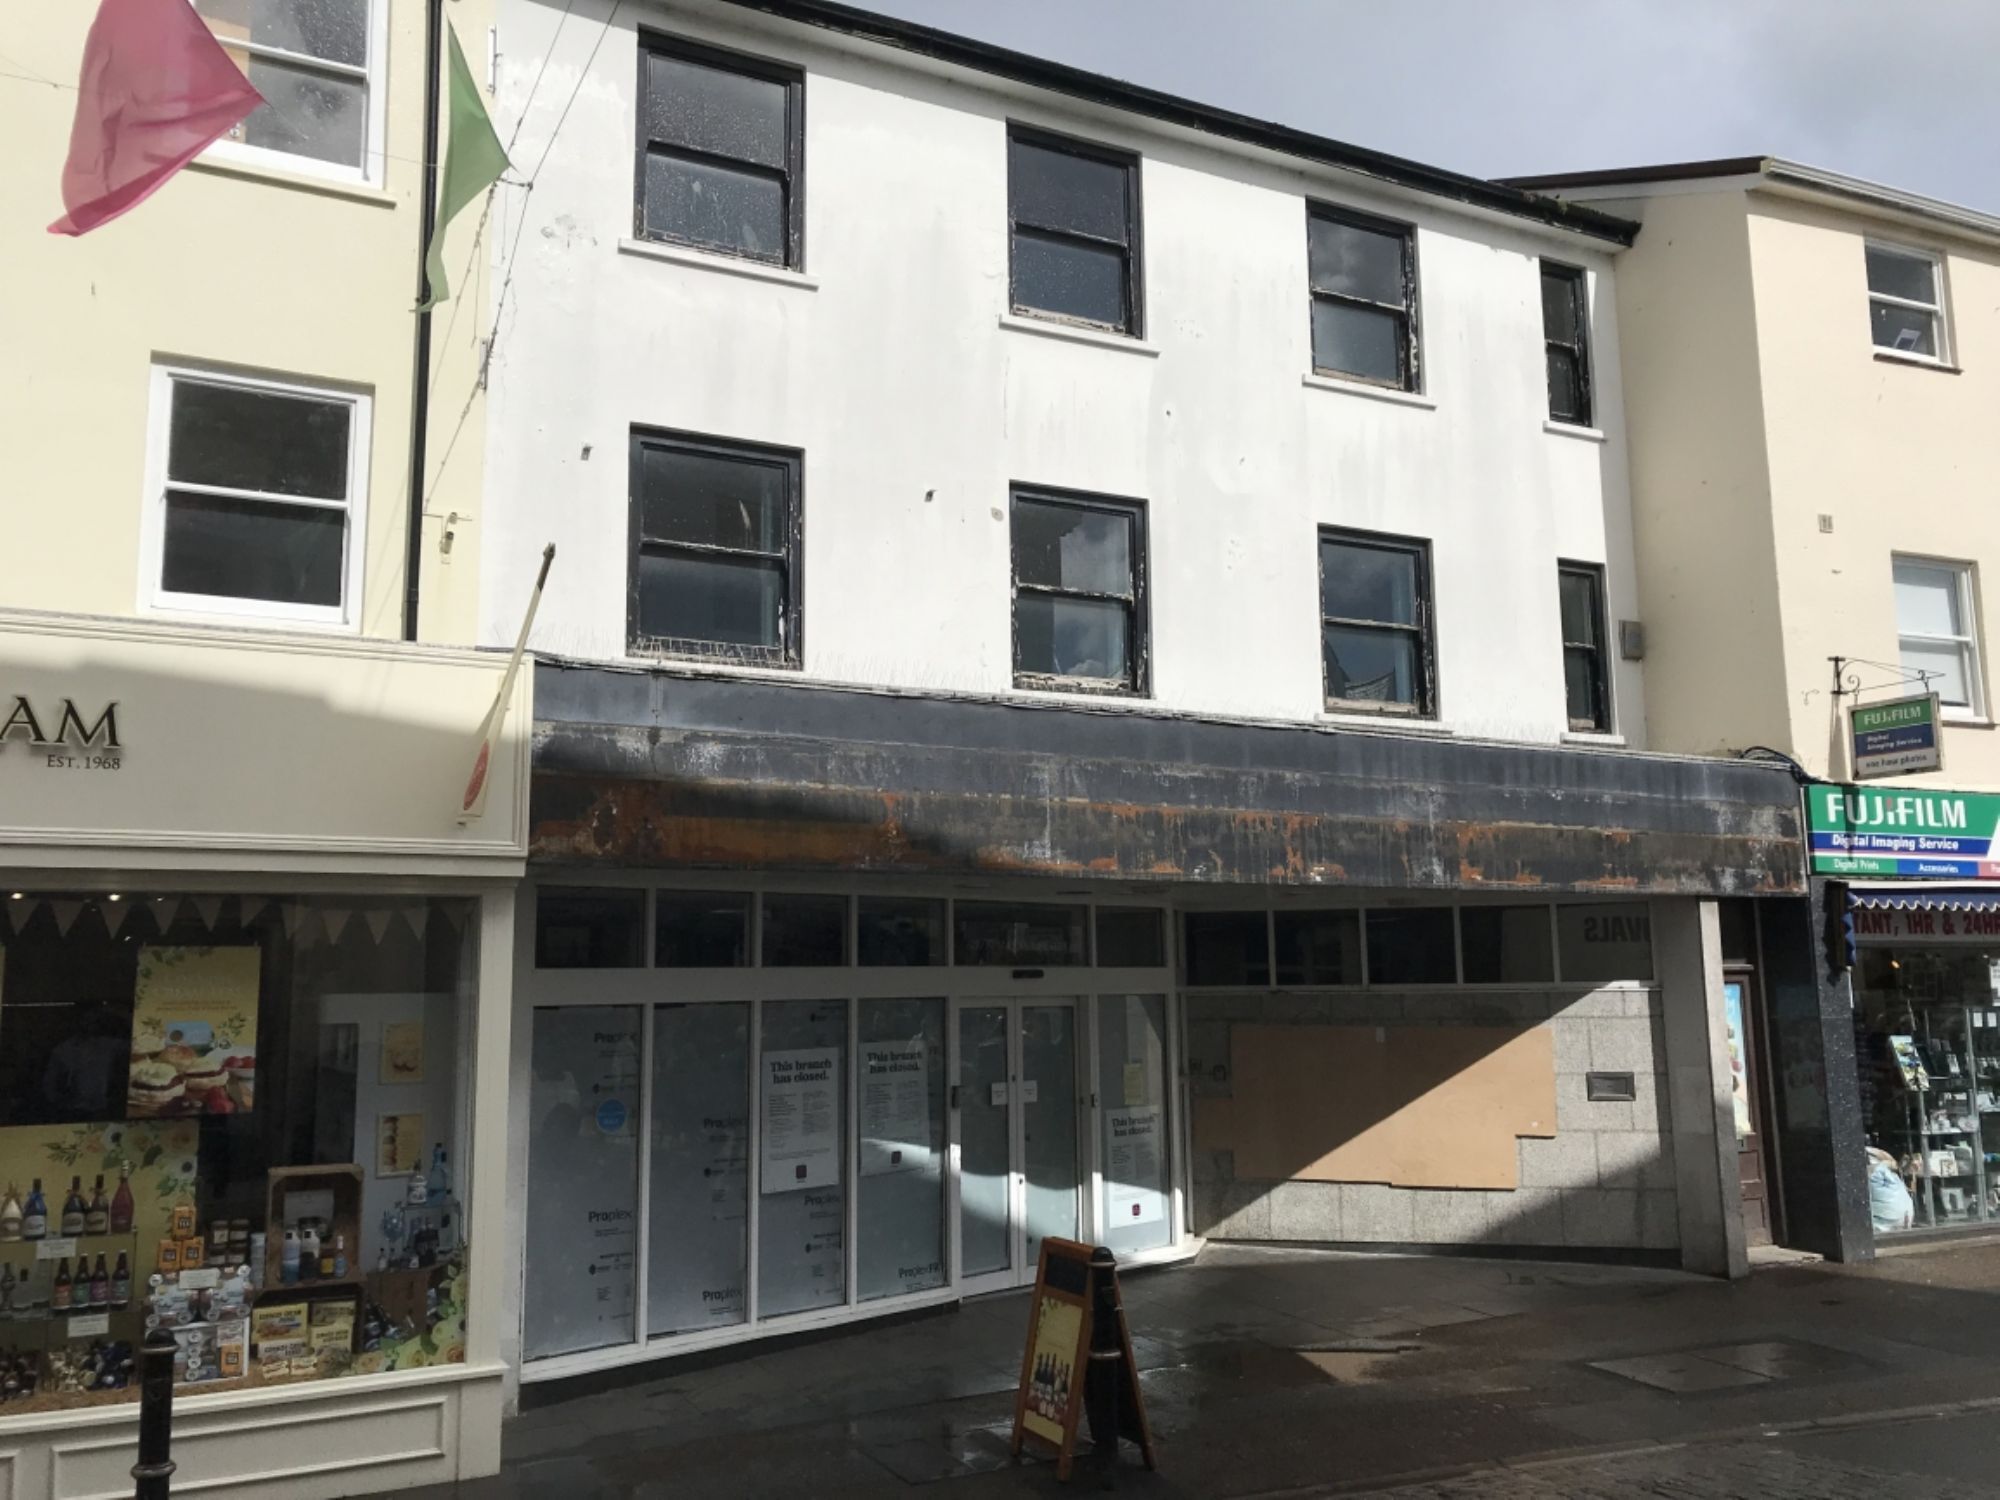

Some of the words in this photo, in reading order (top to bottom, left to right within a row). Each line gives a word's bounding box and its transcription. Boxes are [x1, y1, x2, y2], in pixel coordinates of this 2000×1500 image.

[84, 755, 121, 770] 1968
[1832, 834, 1869, 849] Digital
[1871, 836, 1915, 852] Imaging
[1918, 837, 1959, 851] Service
[1834, 858, 1857, 871] Digital
[1859, 860, 1879, 871] Prints
[1919, 863, 1959, 873] Accessories
[770, 1061, 793, 1073] This
[796, 1058, 832, 1071] branch
[773, 1073, 791, 1084] has
[794, 1070, 830, 1082] closed.
[588, 1209, 633, 1223] Proplex
[702, 1286, 742, 1302] Proplex
